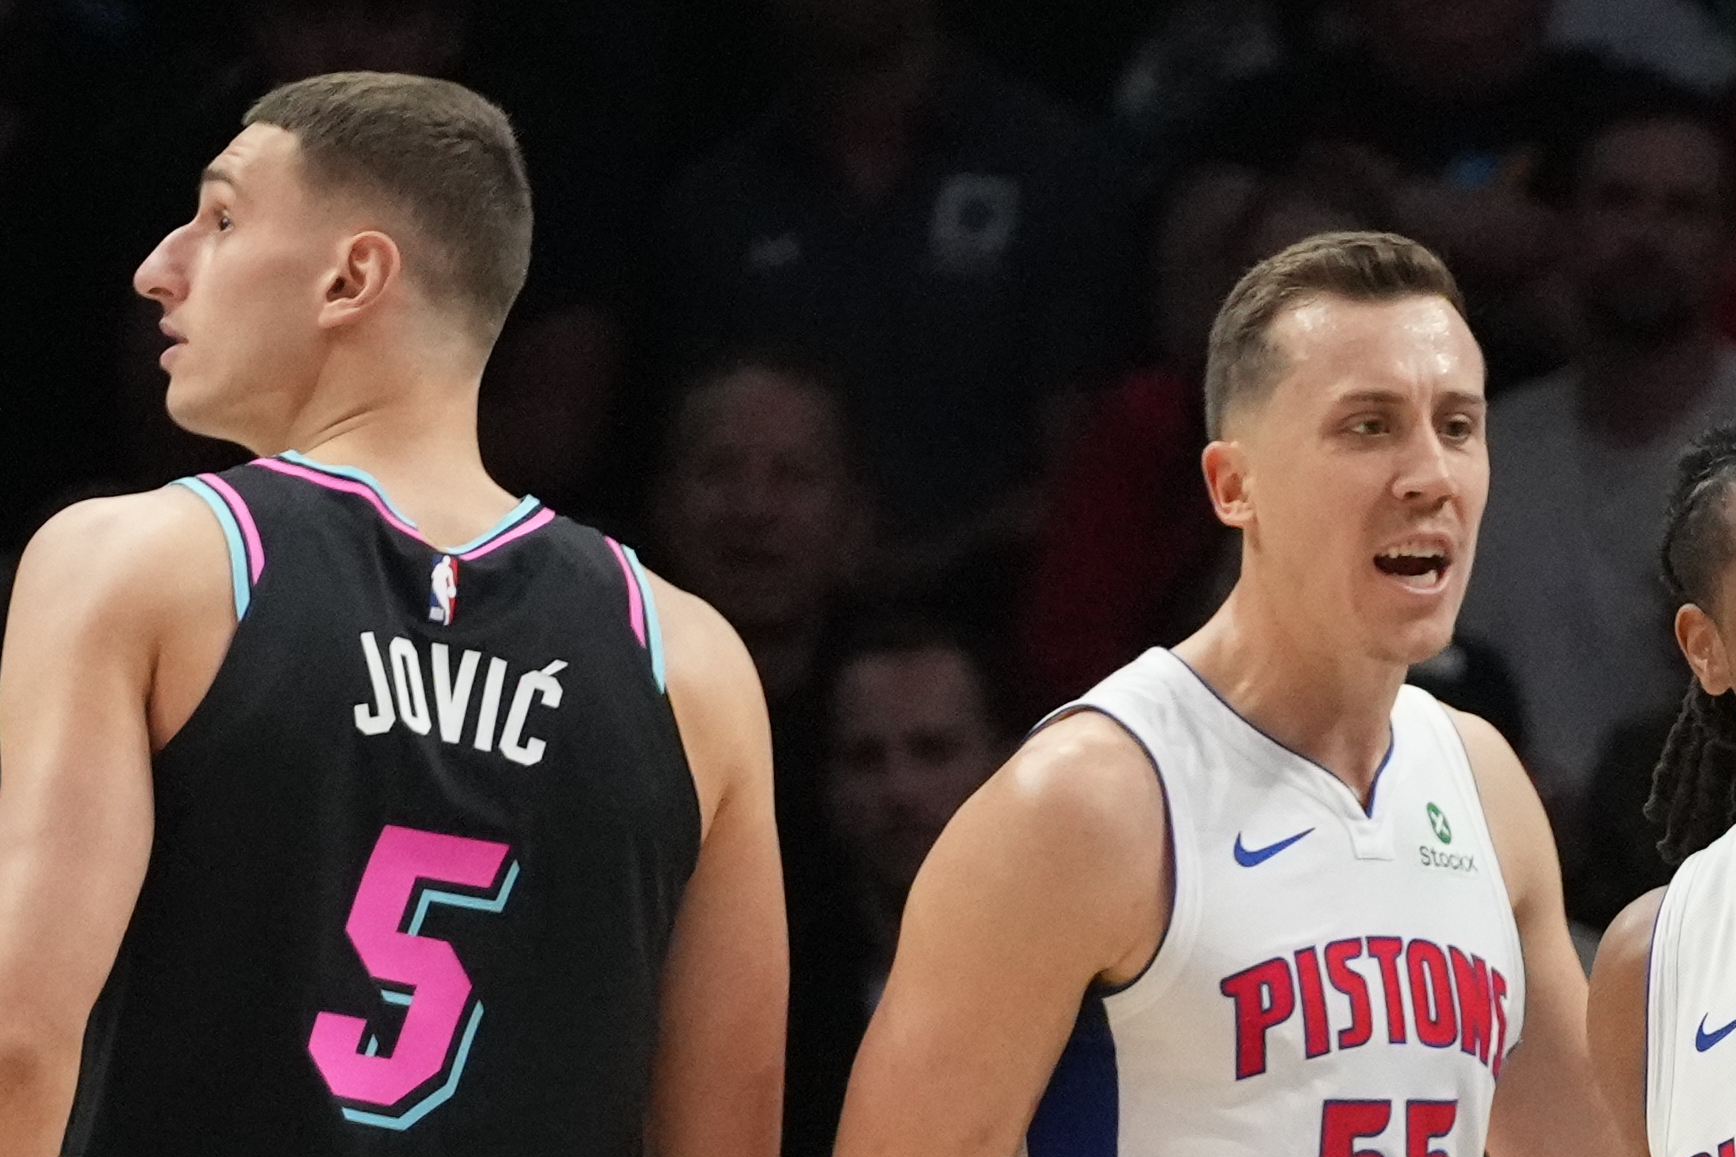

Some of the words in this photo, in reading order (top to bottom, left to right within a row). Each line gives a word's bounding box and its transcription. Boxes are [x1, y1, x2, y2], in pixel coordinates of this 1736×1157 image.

[353, 631, 569, 766] JOVIĆ
[308, 824, 520, 1131] 5
[1219, 935, 1508, 1082] PISTONS
